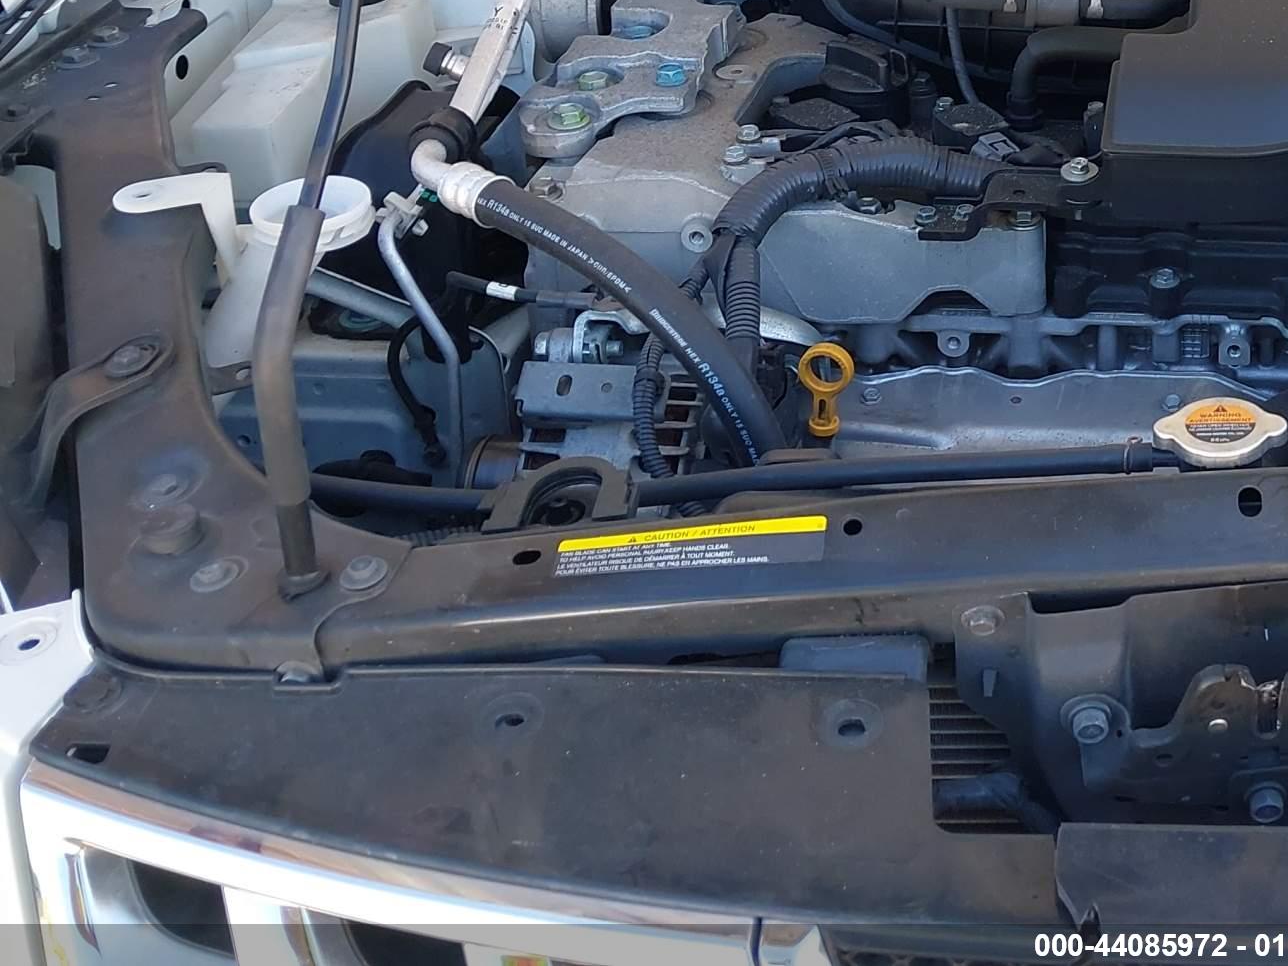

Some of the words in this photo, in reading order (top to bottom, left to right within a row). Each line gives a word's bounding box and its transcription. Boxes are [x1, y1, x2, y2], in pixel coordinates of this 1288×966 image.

[543, 230, 560, 243] MADE
[559, 239, 568, 248] IN
[566, 243, 589, 261] JAPAN
[721, 396, 739, 418] ONLY
[748, 447, 760, 466] MAD
[644, 530, 689, 541] CAUTION
[699, 524, 755, 536] ATTENTION
[566, 560, 608, 568] VENTILATEUR
[686, 551, 705, 559] TOUT
[704, 549, 735, 558] MOMENT.
[607, 551, 641, 559] PERSONAL
[682, 545, 706, 553] HANDS
[690, 556, 733, 565] APPROCHER
